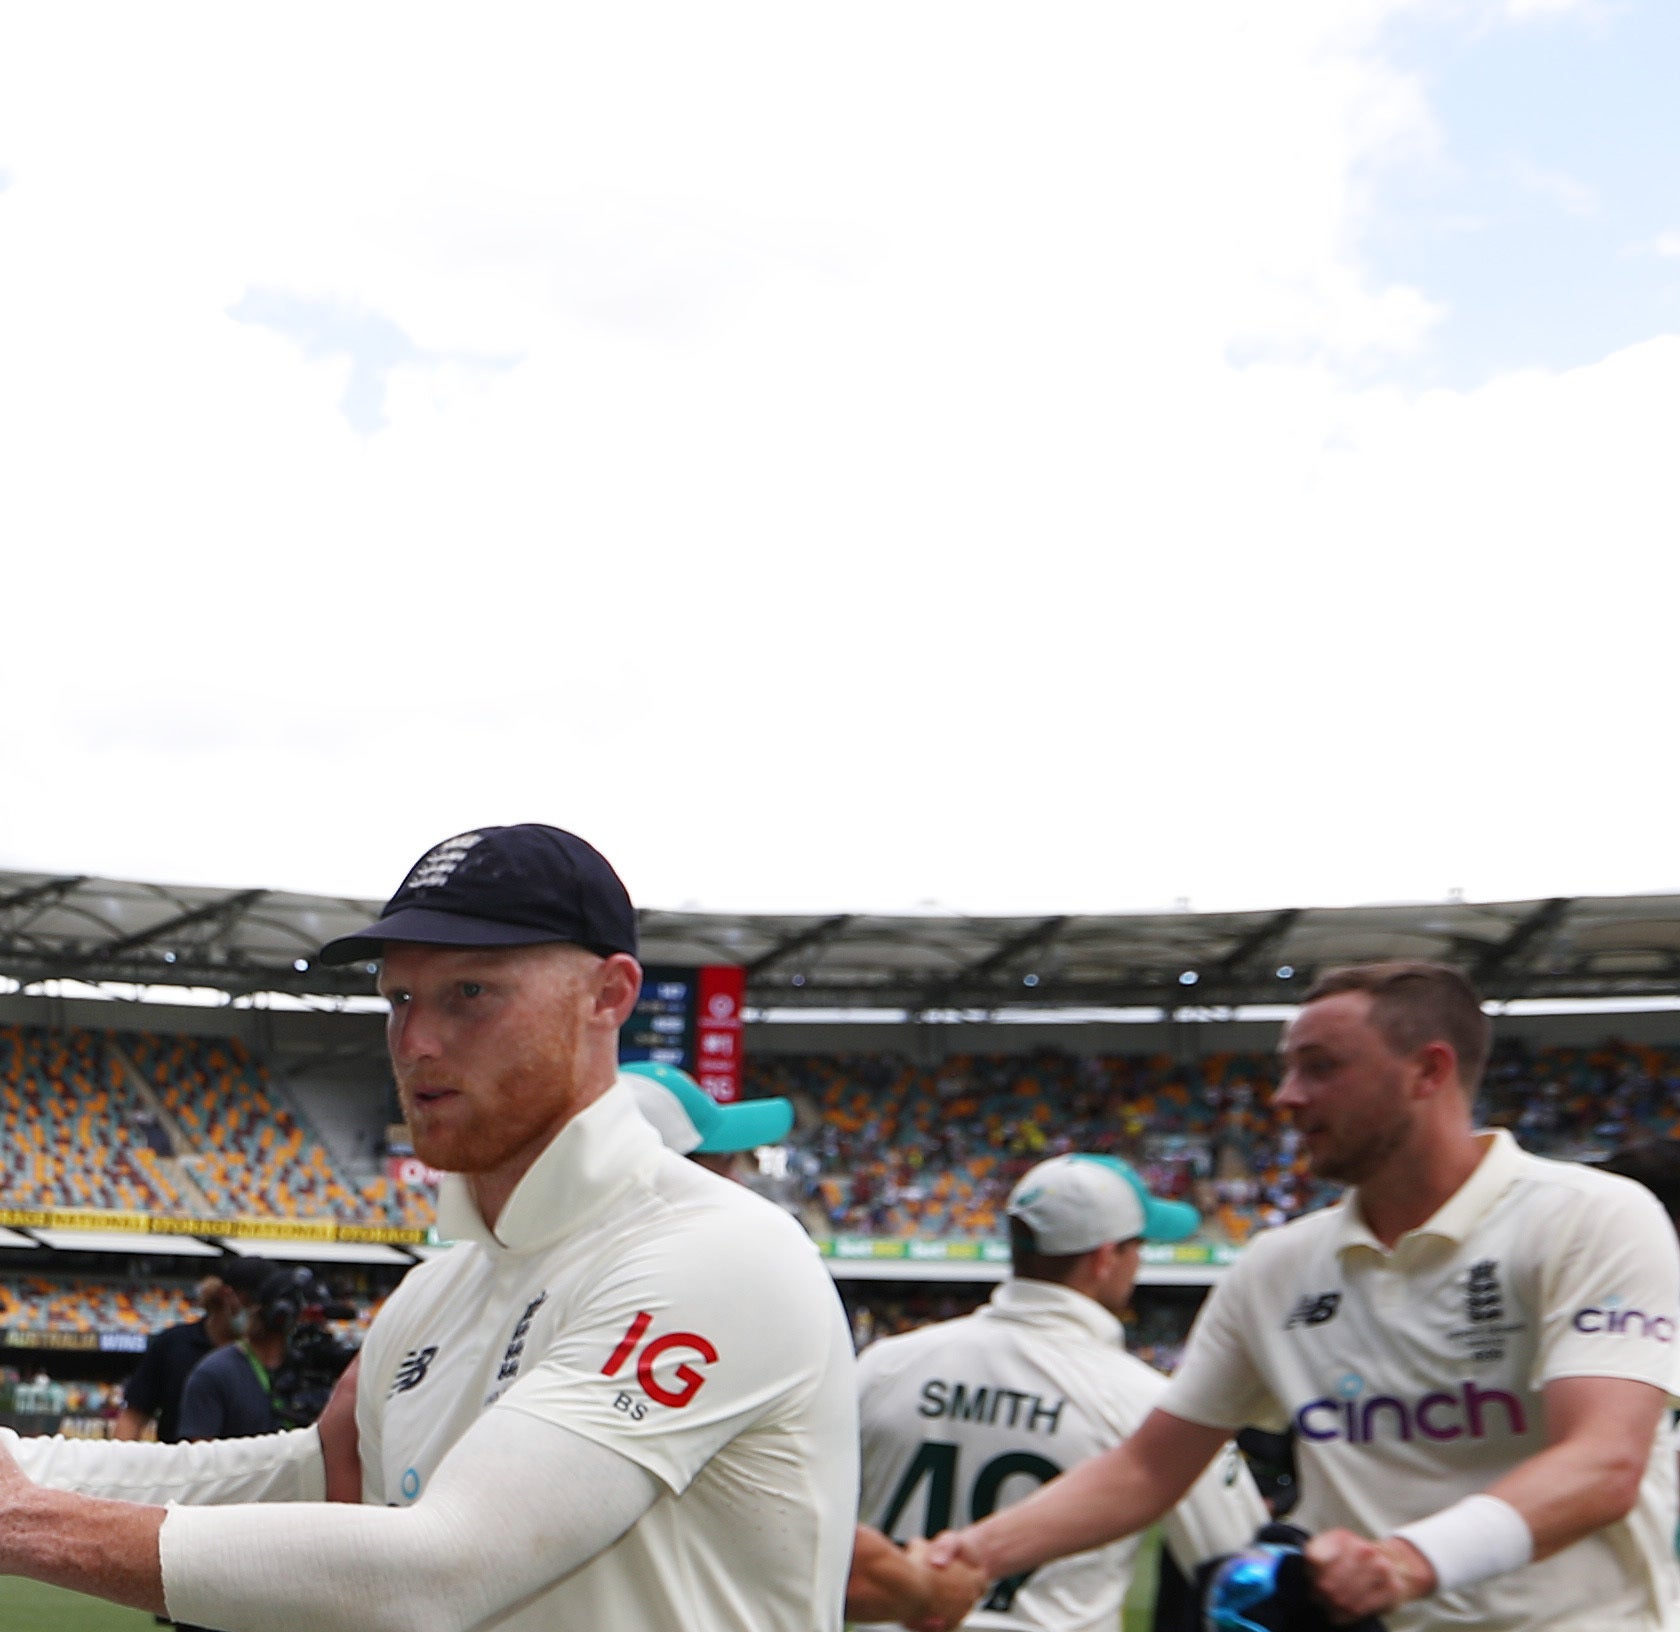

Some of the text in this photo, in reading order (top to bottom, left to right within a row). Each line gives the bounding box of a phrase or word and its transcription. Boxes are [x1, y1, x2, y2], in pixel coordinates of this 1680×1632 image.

[601, 1311, 719, 1408] IG
[612, 1391, 648, 1421] BS
[917, 1378, 1065, 1434] SMITH
[1296, 1373, 1528, 1443] cinch
